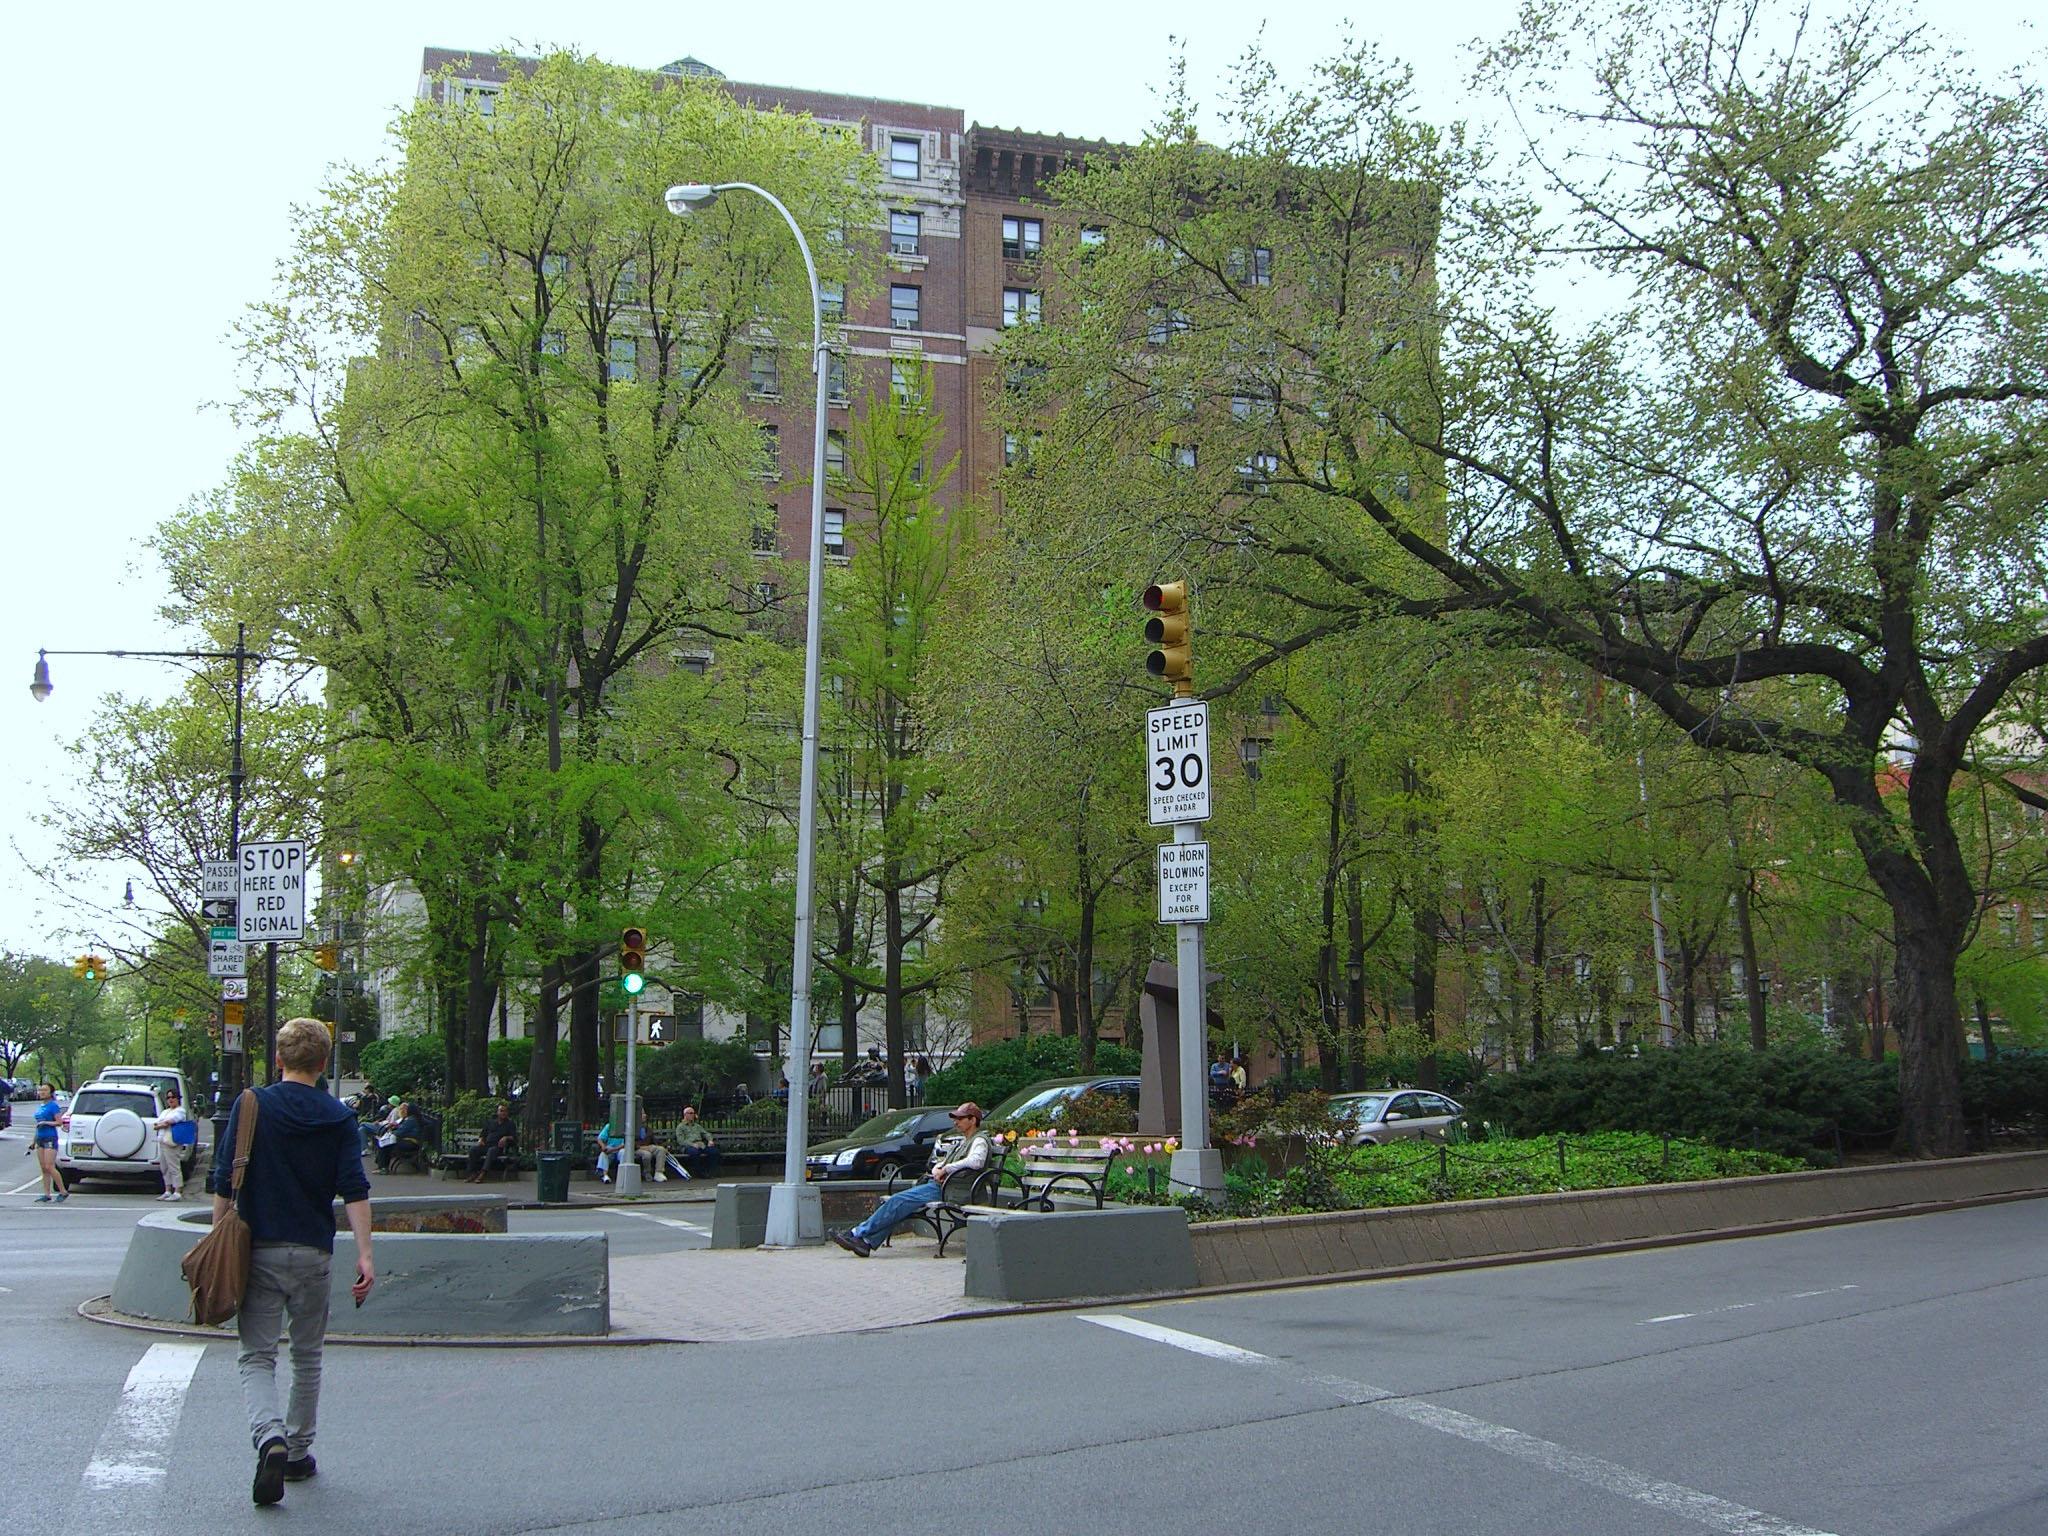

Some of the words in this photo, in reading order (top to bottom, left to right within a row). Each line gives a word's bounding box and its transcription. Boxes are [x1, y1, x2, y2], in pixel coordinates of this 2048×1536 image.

[1150, 713, 1204, 734] SPEED
[1156, 733, 1198, 752] LIMIT
[1154, 753, 1203, 791] 30
[1153, 795, 1174, 805] SPEED
[1176, 791, 1206, 803] CHECKED
[1163, 806, 1172, 814] BY
[1174, 802, 1196, 813] RADAR
[244, 848, 300, 871] STOP
[1162, 851, 1175, 863] NO
[1179, 849, 1205, 862] HORN
[206, 866, 238, 877] PASSEN
[1163, 866, 1205, 880] BLOWING
[205, 880, 228, 892] CARS
[243, 876, 276, 892] HERE
[282, 875, 300, 890] ON
[1169, 883, 1198, 893] EXCEPT
[257, 896, 286, 911] RED
[1176, 894, 1192, 903] FOR
[216, 905, 228, 914] ON
[1168, 904, 1200, 914] DANGER
[243, 916, 299, 932] SIGNAL
[212, 954, 244, 963] SHARED
[217, 964, 238, 972] LANE
